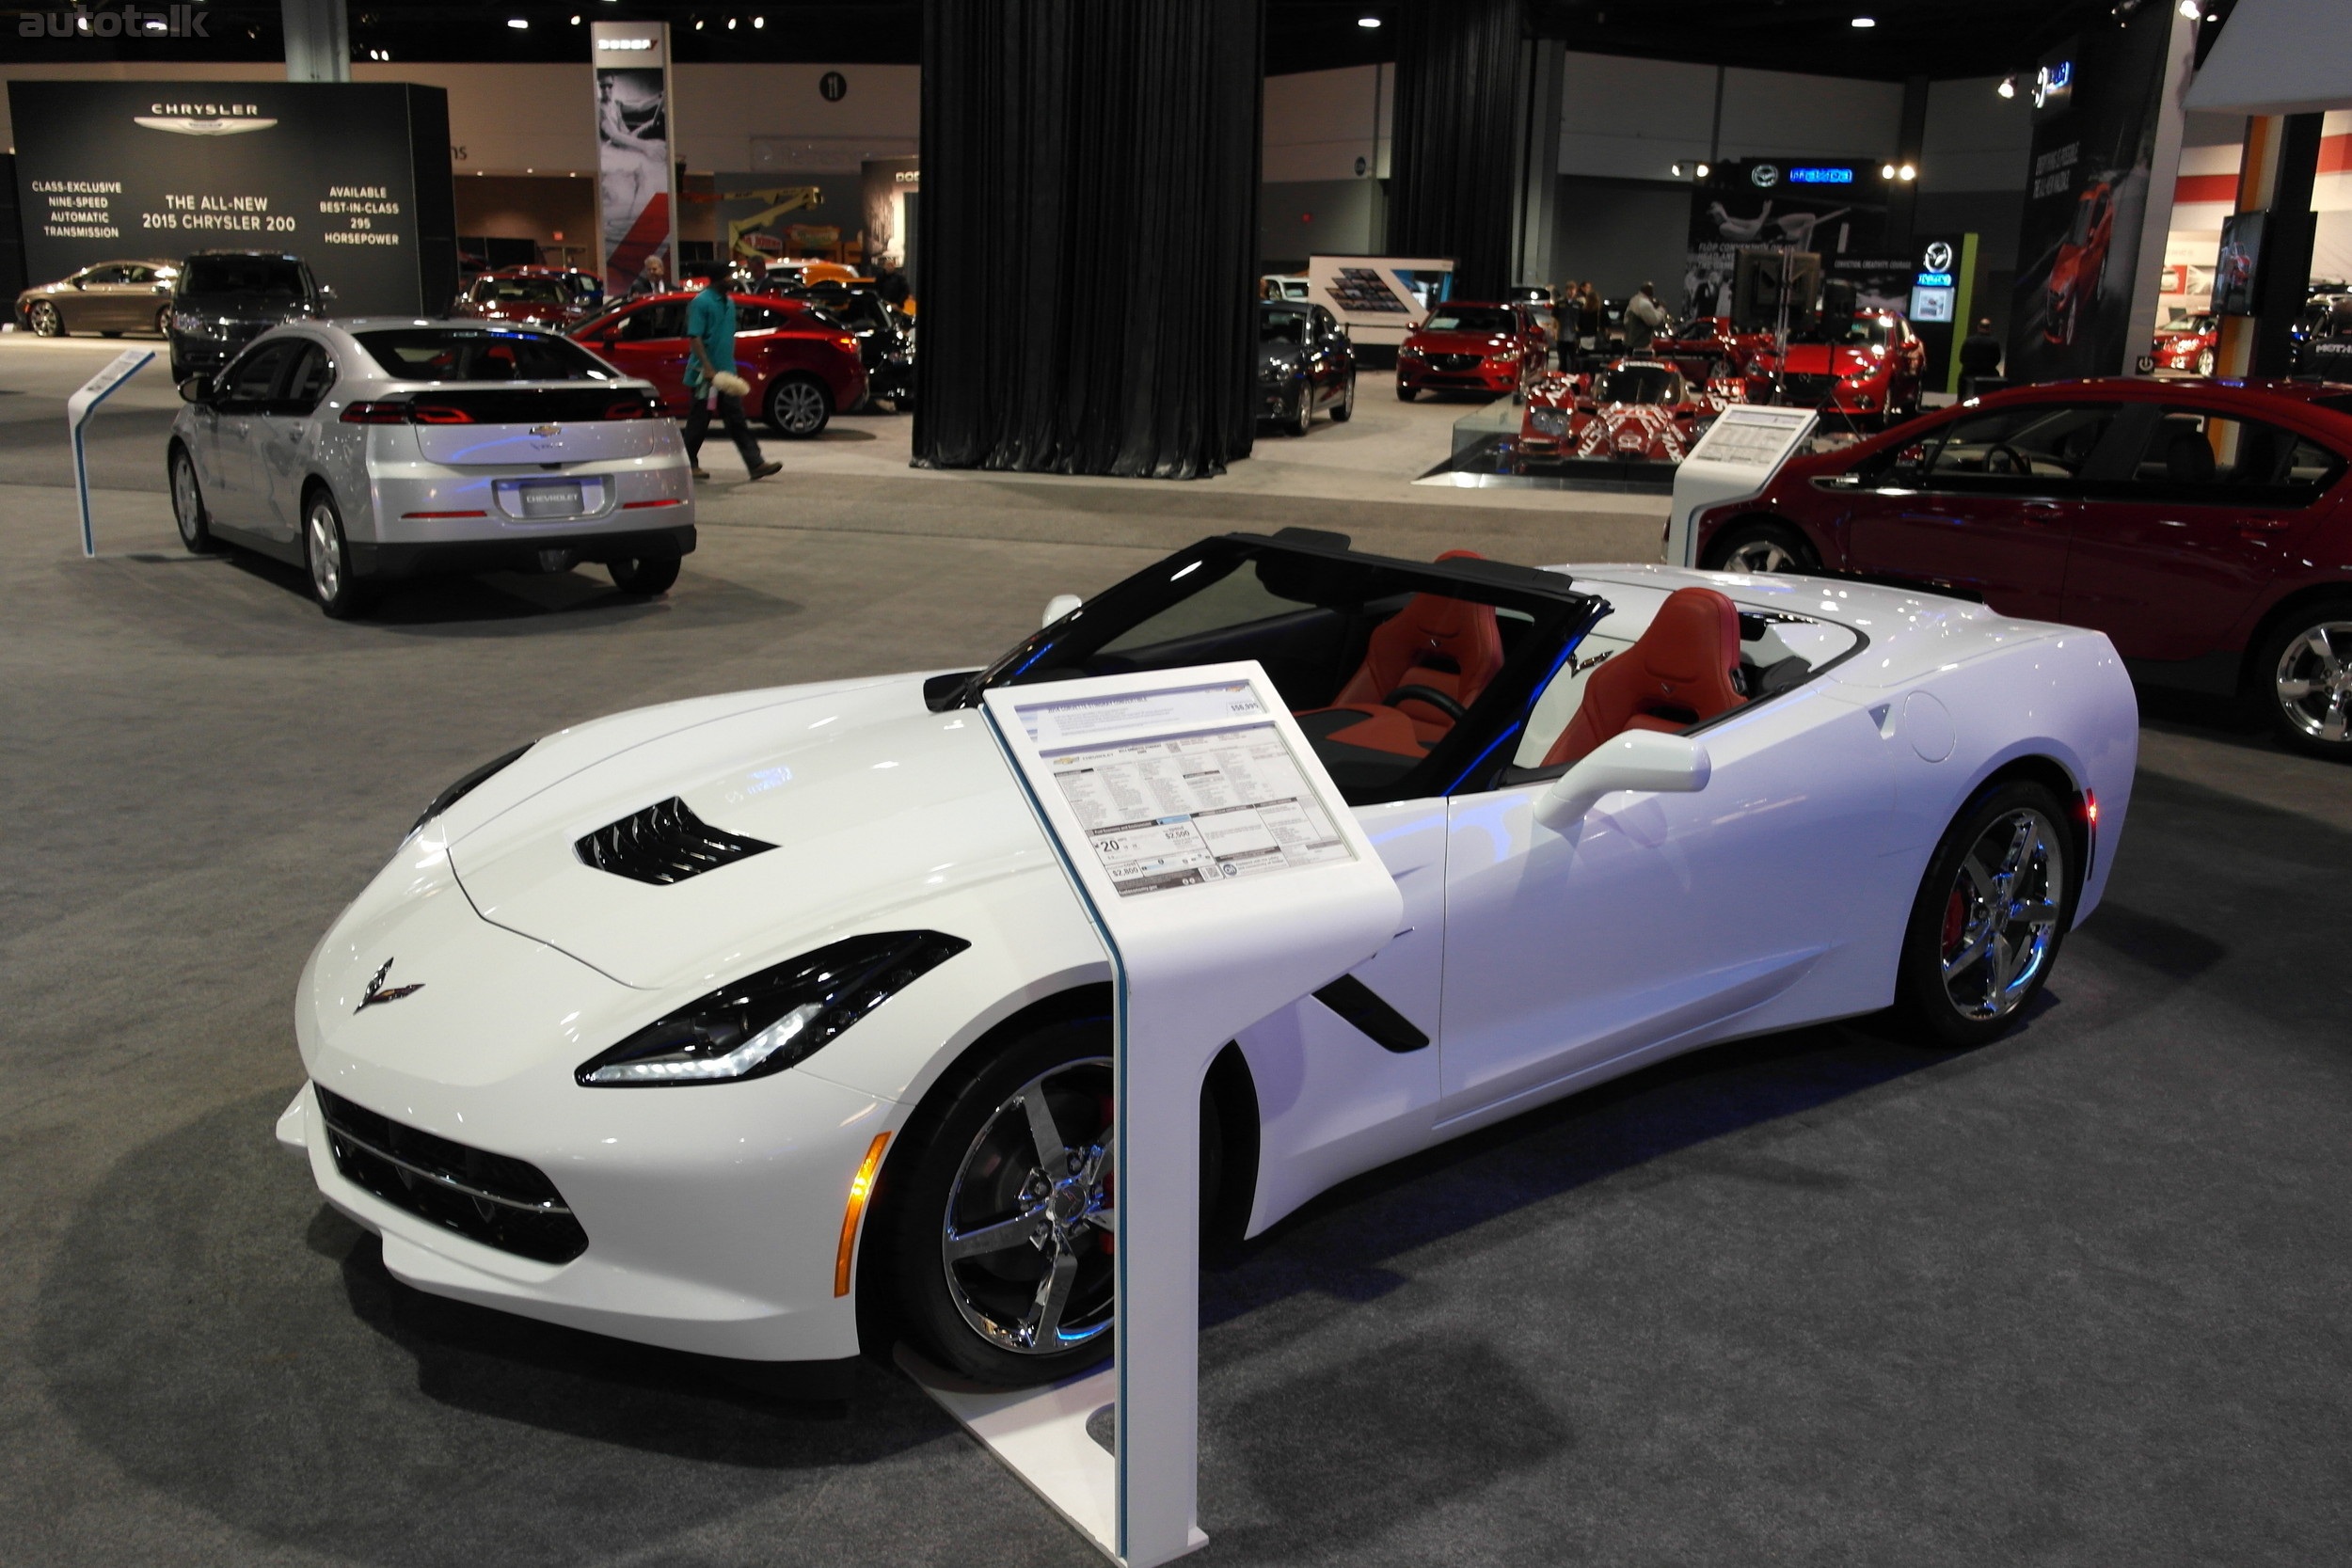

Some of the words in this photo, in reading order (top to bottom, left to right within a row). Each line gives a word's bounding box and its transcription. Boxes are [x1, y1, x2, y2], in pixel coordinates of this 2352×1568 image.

[151, 103, 258, 116] CHRYSLER
[32, 181, 122, 194] CLASS-EXCLUSIVE
[329, 186, 388, 199] AVAILABLE
[49, 196, 108, 209] NINE-SPEED
[165, 194, 196, 211] THE
[200, 195, 268, 212] ALL-NEW
[319, 200, 400, 214] BEST-IN-CLASS
[51, 211, 109, 224] AUTOMATIC
[142, 213, 178, 229] 2015
[182, 214, 261, 230] CHRYSLER
[265, 215, 296, 232] 200
[350, 217, 371, 230] 295
[43, 225, 119, 239] TRANSMISSION
[325, 231, 400, 245] HORSEPOWER
[526, 494, 579, 503] CHEVROLET
[1100, 839, 1120, 852] 20
